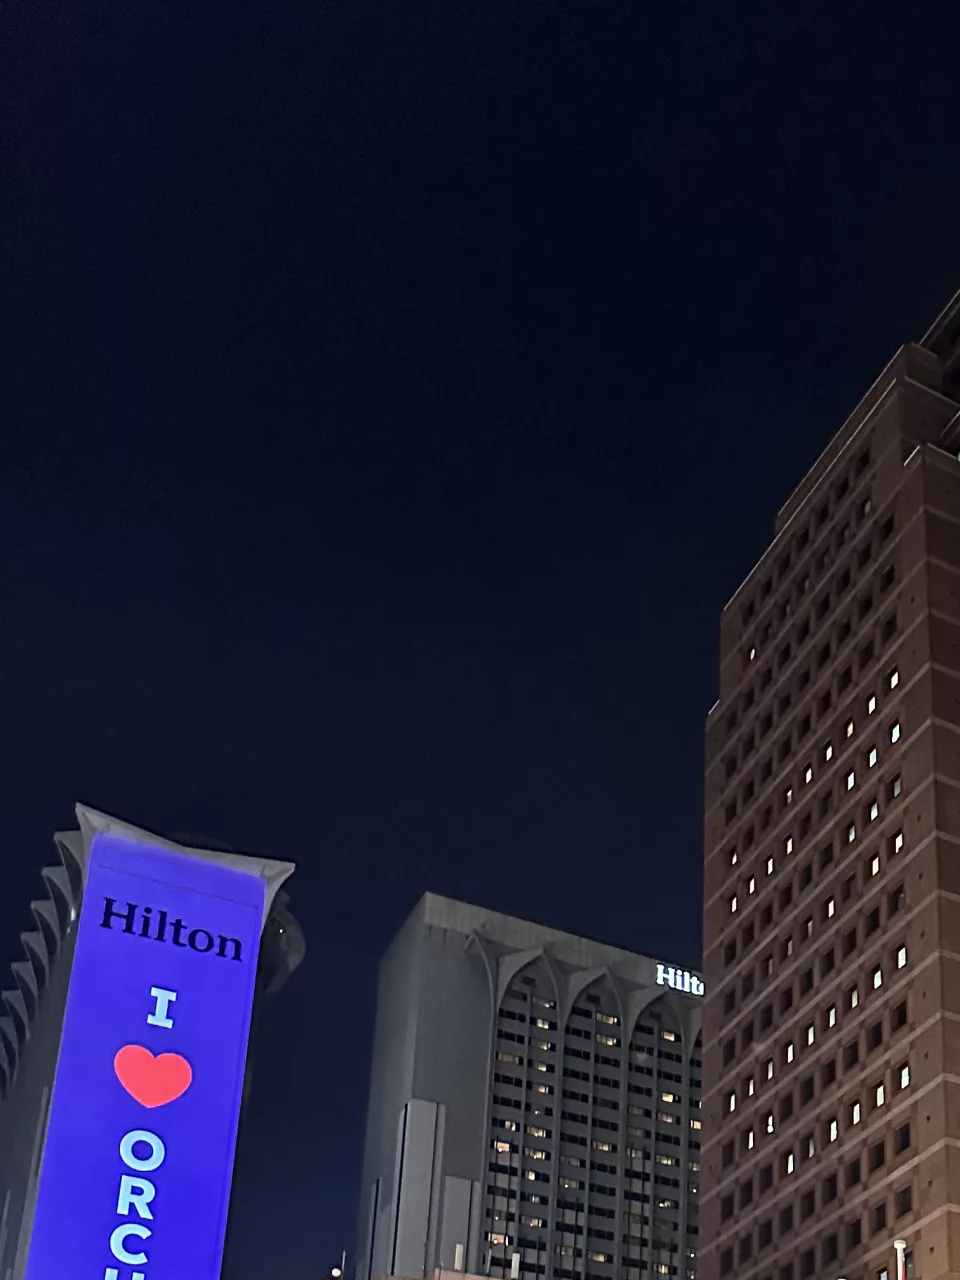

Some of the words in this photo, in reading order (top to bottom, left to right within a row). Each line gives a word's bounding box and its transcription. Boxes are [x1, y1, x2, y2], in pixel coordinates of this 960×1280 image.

[99, 896, 243, 963] Hilton
[656, 964, 705, 995] Hilt
[147, 986, 177, 1029] I
